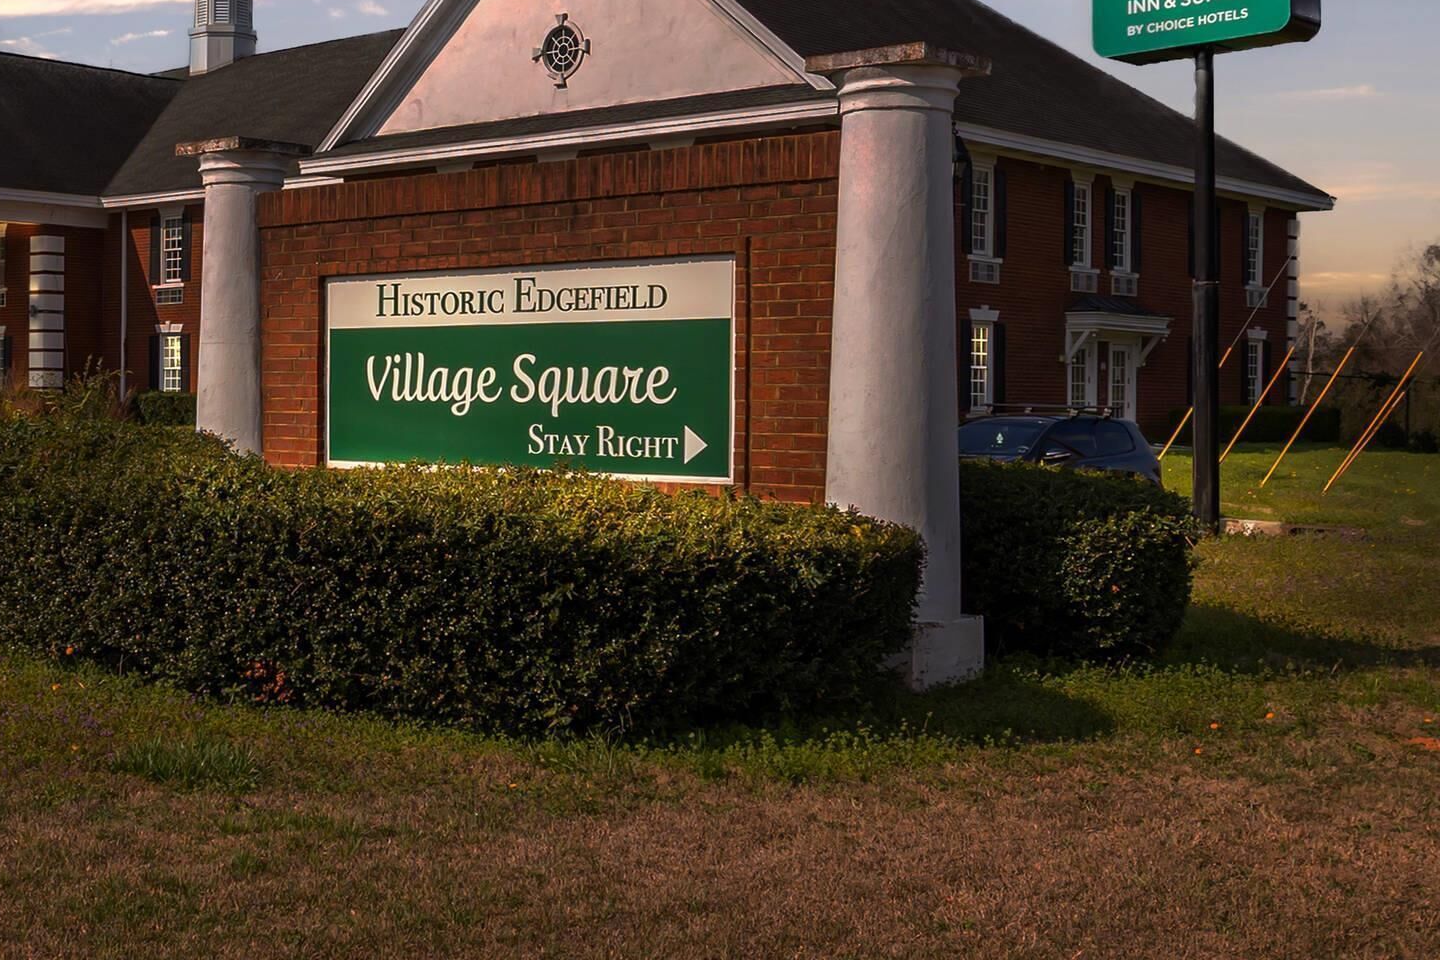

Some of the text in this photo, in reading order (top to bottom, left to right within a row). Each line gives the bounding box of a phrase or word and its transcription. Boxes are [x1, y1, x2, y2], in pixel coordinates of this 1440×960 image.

[1127, 8, 1248, 36] BY CHOICE HOTELS
[376, 277, 668, 317] HISTORIC EDGEFIELD
[366, 352, 677, 417] Village Square
[528, 423, 678, 459] STAY RIGHT
